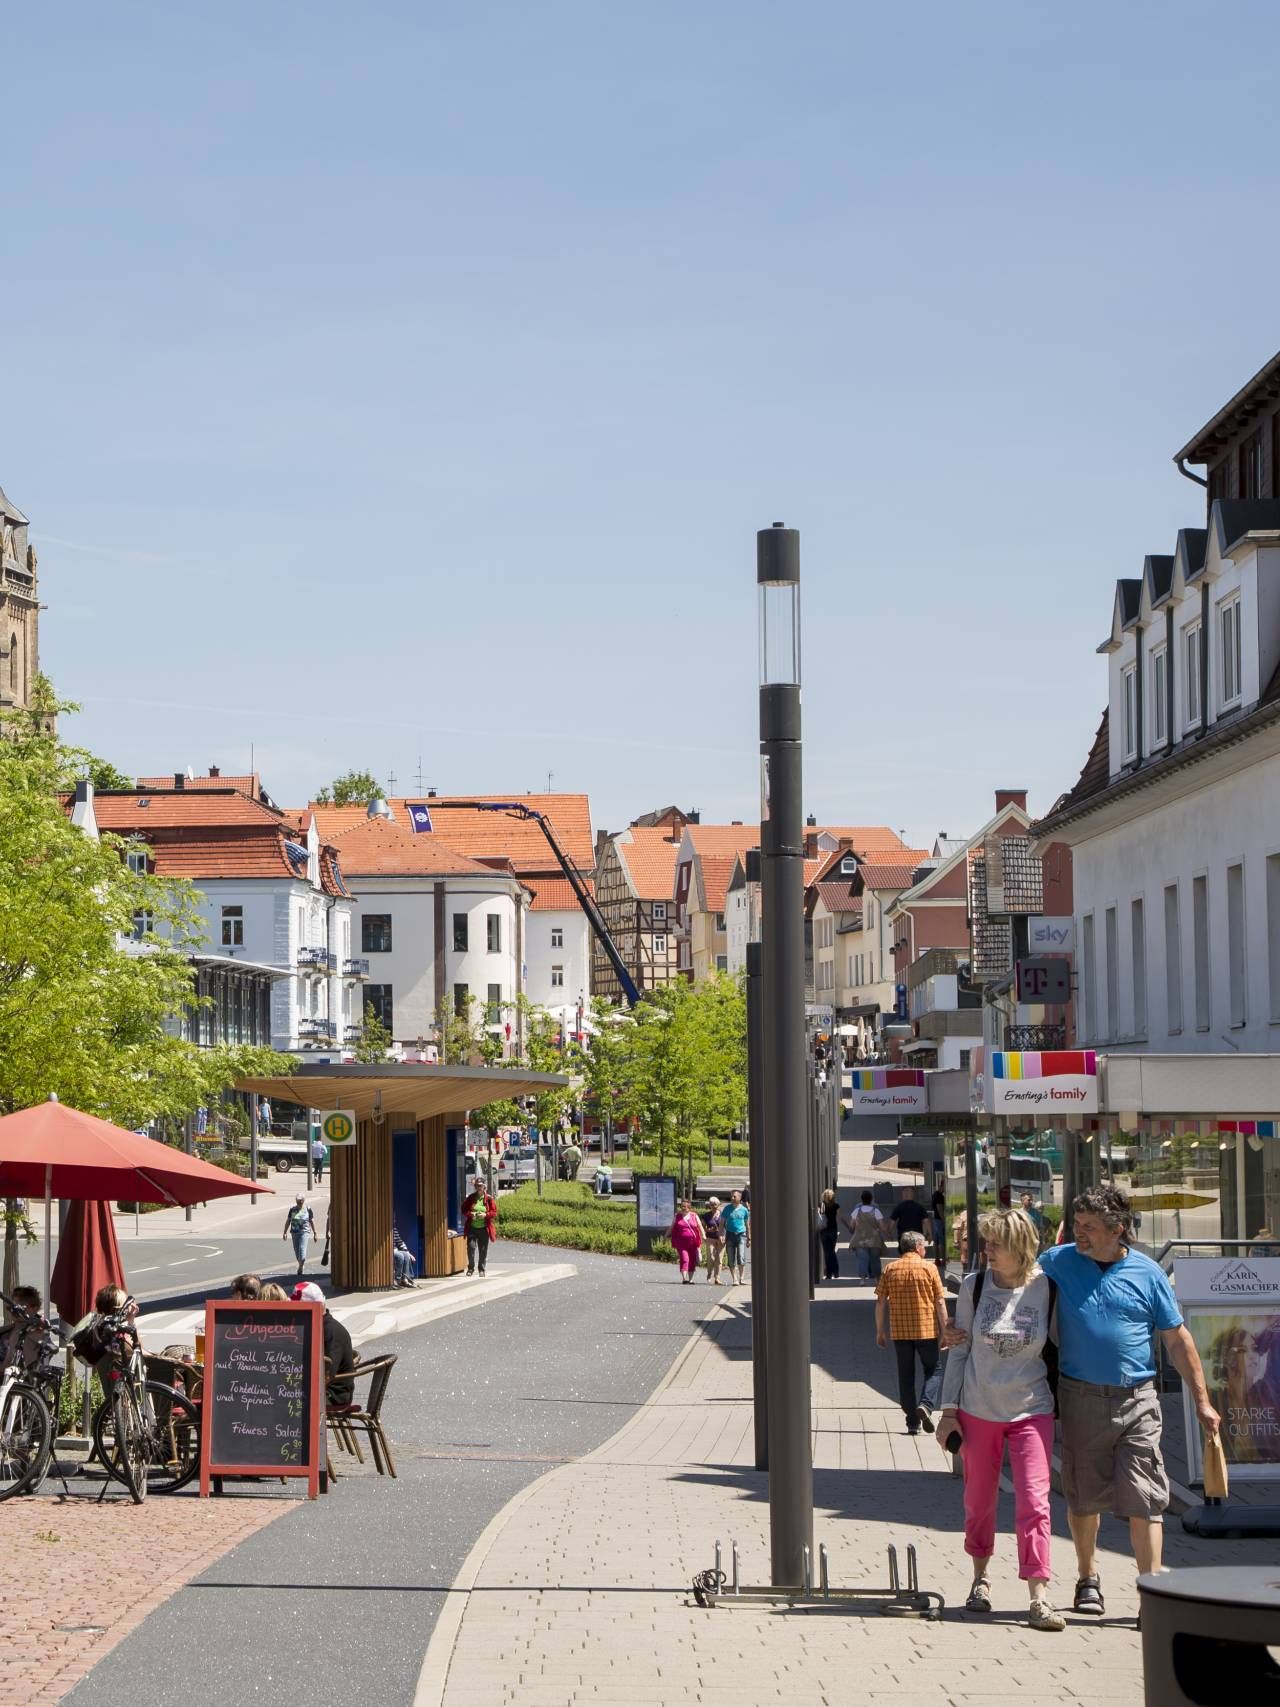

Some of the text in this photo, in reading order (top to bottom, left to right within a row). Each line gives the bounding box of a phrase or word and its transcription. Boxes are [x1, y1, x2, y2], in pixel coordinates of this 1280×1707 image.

[1034, 925, 1069, 944] sky
[892, 1095, 918, 1105] family
[1003, 1087, 1087, 1103] Ernsting's family
[332, 1119, 345, 1136] H
[511, 1133, 518, 1145] P
[1227, 1271, 1258, 1280] KARIN
[1210, 1283, 1279, 1292] GLASMACHER
[235, 1317, 297, 1344] Angebot
[230, 1348, 296, 1363] Grill Teller
[279, 1363, 304, 1374] Salat
[241, 1395, 275, 1412] Spinat
[1227, 1407, 1276, 1420] STARKE
[232, 1421, 302, 1438] Fitness Salat
[1229, 1423, 1280, 1437] OUTFITS
